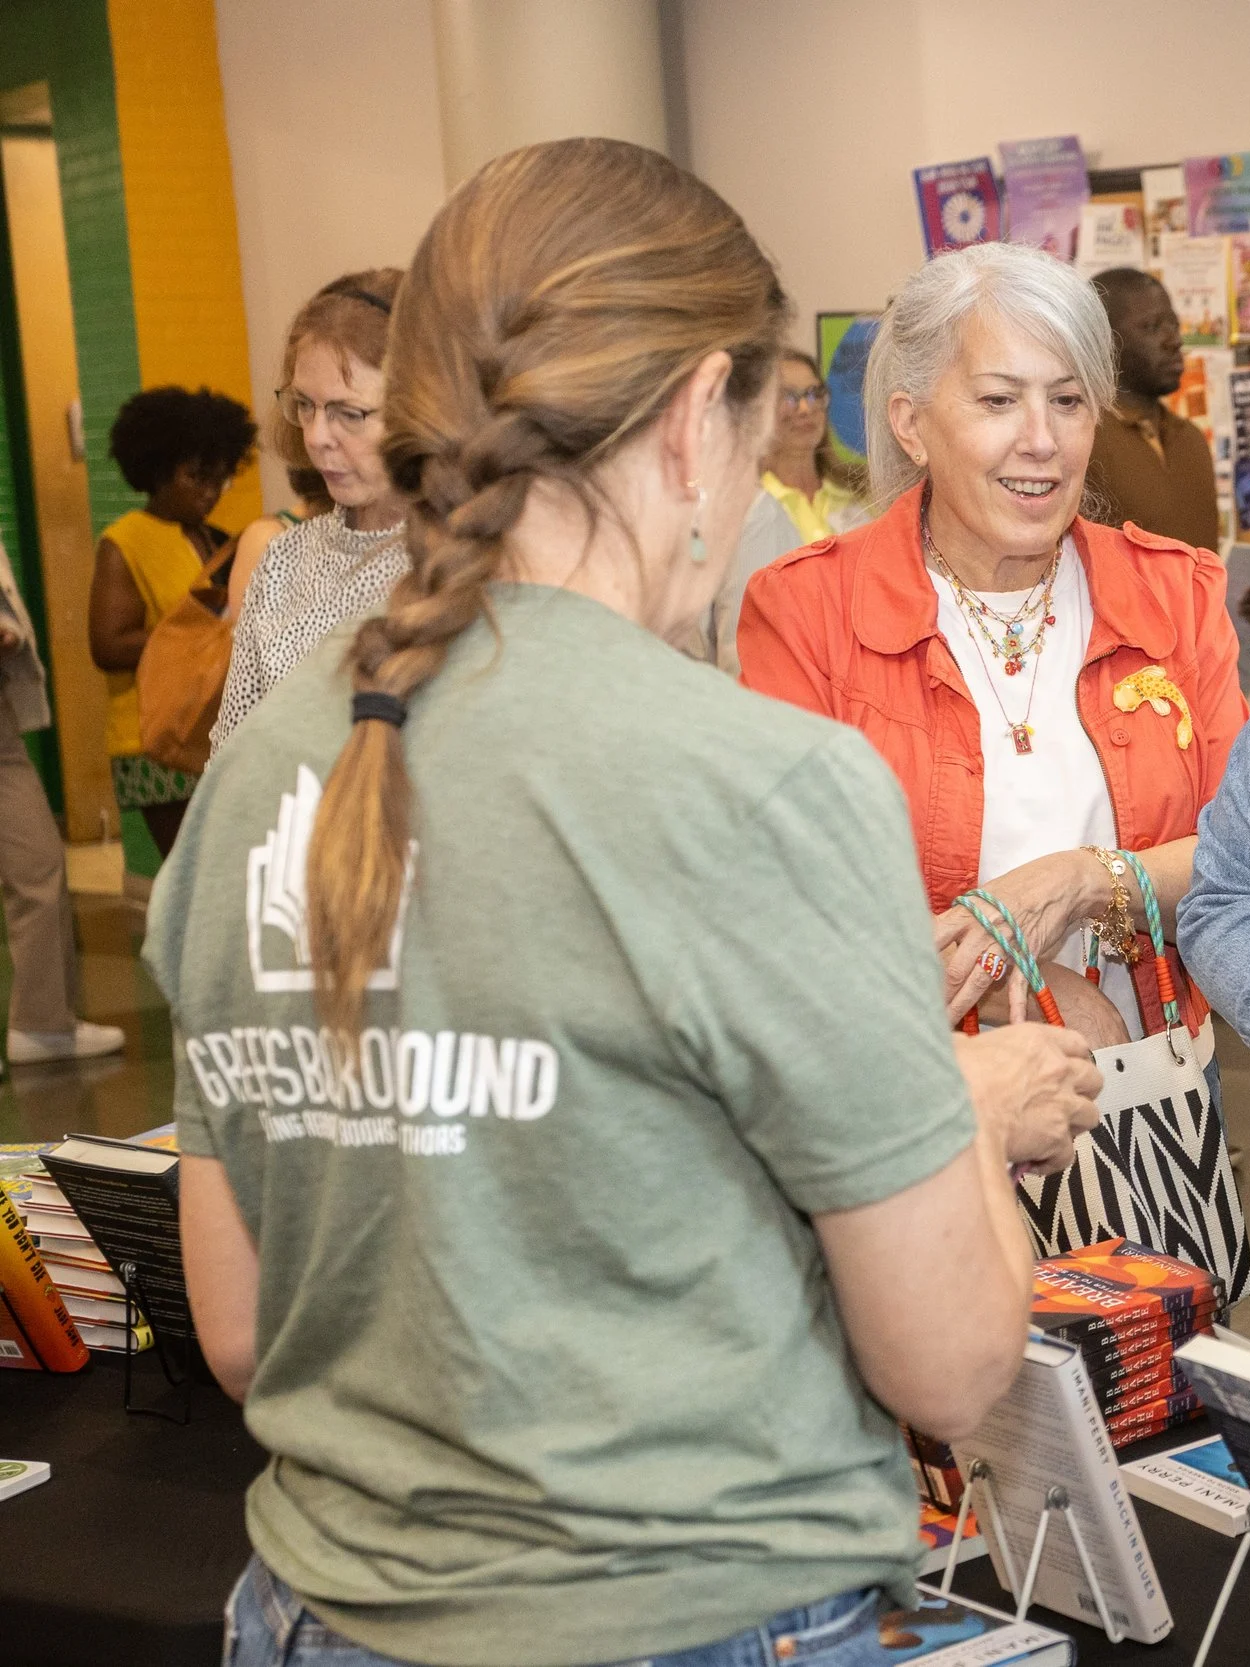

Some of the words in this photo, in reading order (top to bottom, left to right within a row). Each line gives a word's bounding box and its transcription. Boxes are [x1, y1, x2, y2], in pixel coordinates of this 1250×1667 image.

[2, 1207, 19, 1231] YOU
[13, 1229, 37, 1262] DON'T
[30, 1258, 46, 1284] DIE
[1088, 1307, 1149, 1331] BREATHE
[1101, 1320, 1158, 1346] BREATHE
[1105, 1335, 1157, 1362] BREATHE
[1110, 1352, 1162, 1380] BREATHE
[1106, 1370, 1159, 1397] BREATHE
[1104, 1387, 1160, 1415] BREATHE
[1112, 1424, 1152, 1446] EATHE
[1071, 1369, 1090, 1413] IMANI
[1088, 1416, 1110, 1466] PERRY
[1109, 1480, 1131, 1530] BLACK
[1128, 1533, 1138, 1549] IN
[1134, 1551, 1155, 1601] BLUES
[1138, 1464, 1193, 1488] PERRY
[1194, 1487, 1245, 1510] IMANI
